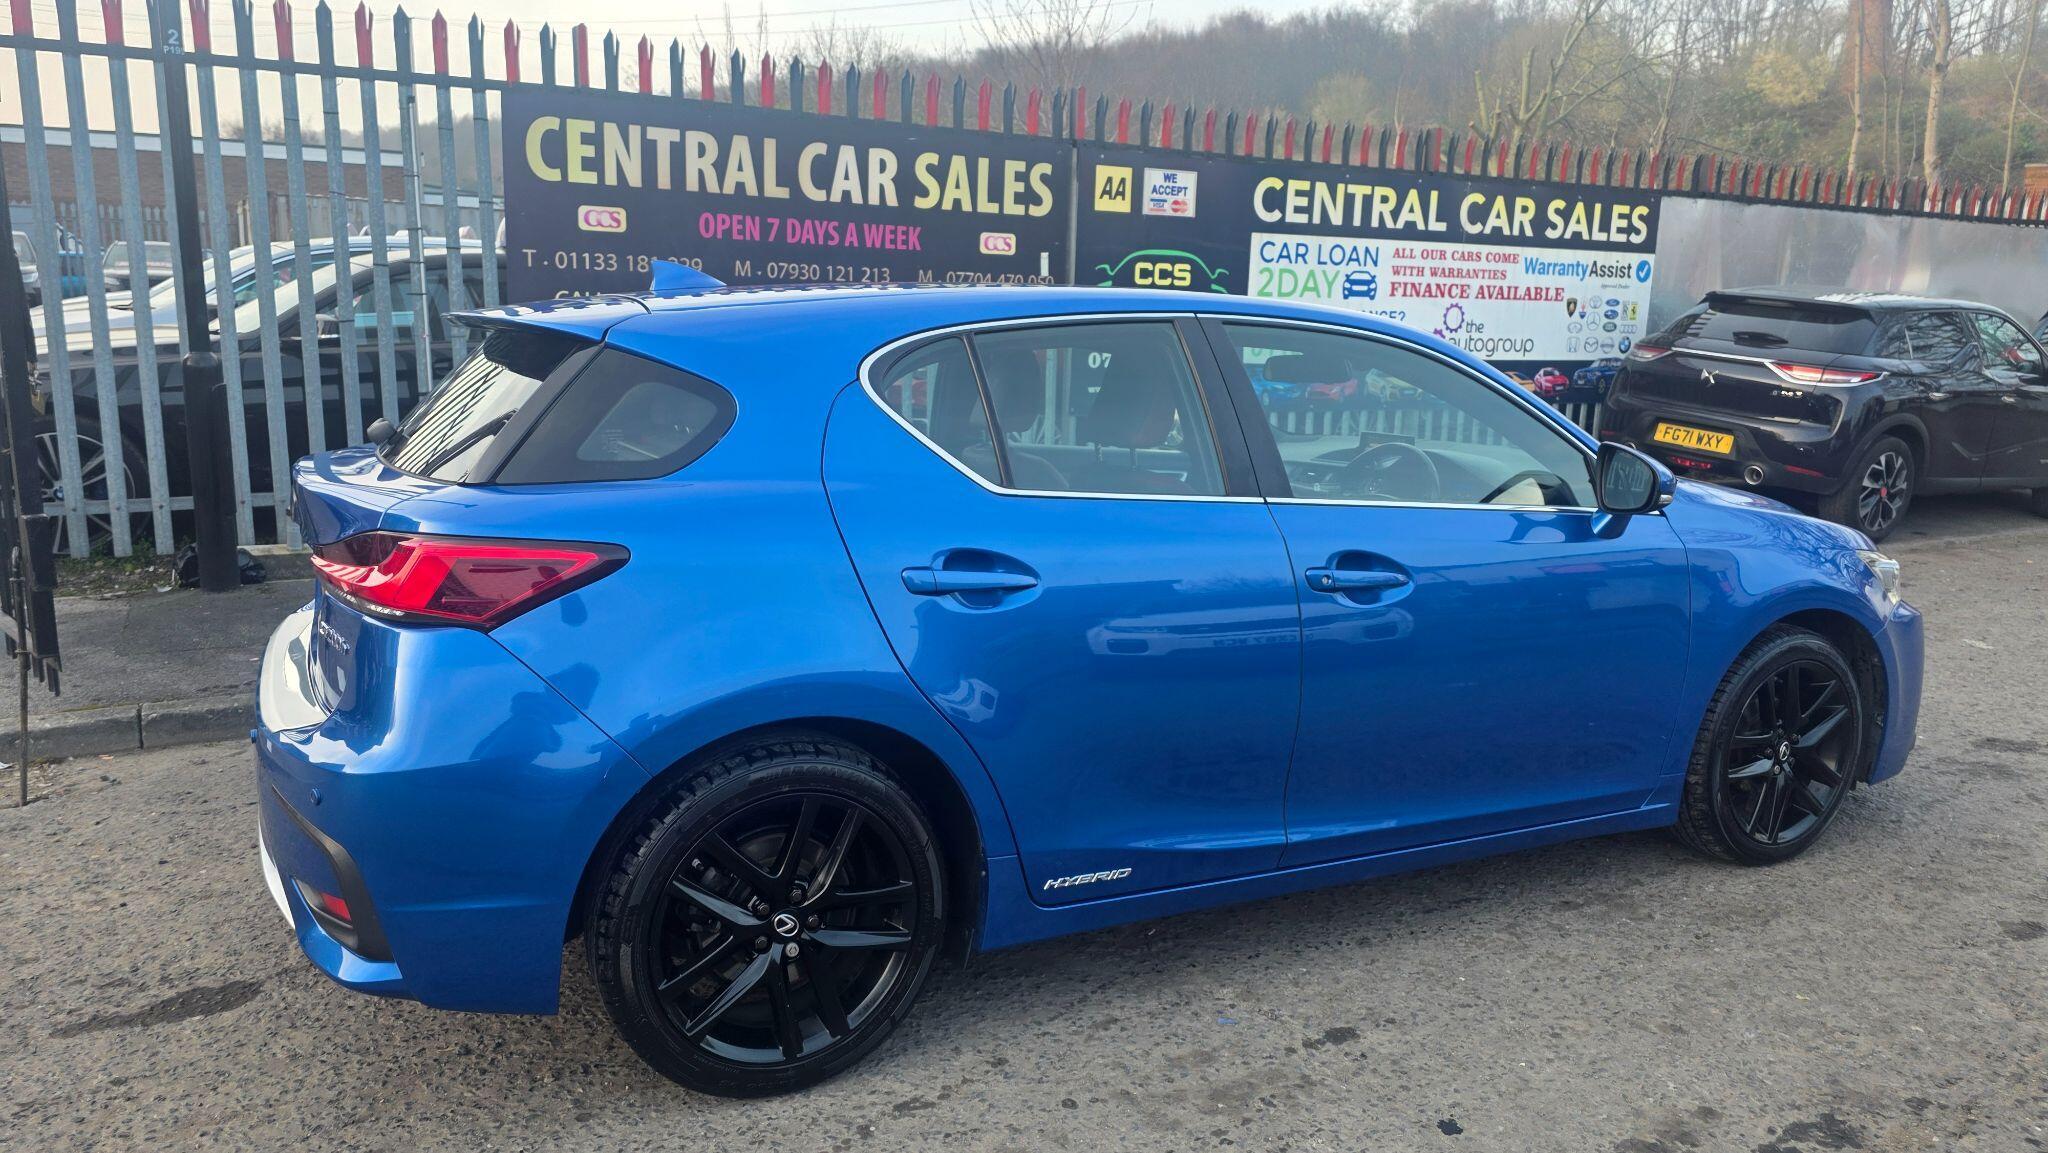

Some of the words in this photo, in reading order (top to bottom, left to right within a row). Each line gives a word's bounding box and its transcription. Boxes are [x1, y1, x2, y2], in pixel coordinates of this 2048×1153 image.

[168, 29, 179, 45] 2
[525, 116, 791, 199] CENTRAL
[798, 142, 899, 207] CAR
[913, 152, 1053, 217] SALES
[1099, 176, 1127, 201] AA
[1163, 172, 1178, 184] WE
[1151, 184, 1188, 197] ACCEPT
[583, 209, 622, 229] CCS
[1253, 176, 1447, 231] CENTRAL
[1459, 192, 1536, 238] CAR
[1544, 199, 1650, 244] SALES
[699, 212, 760, 241] OPEN
[767, 217, 780, 242] 7
[786, 218, 839, 246] DAYS
[844, 223, 859, 247] A
[863, 223, 921, 250] WEEK
[984, 235, 1012, 252] CCS
[1259, 240, 1309, 264] CAR
[1317, 243, 1379, 267] LOAN
[554, 251, 618, 271] 01133
[1392, 247, 1416, 260] ALL
[1420, 249, 1447, 261] OUR
[1451, 250, 1482, 263] CARS
[1485, 252, 1520, 264] COME
[767, 262, 820, 280] 07930
[827, 265, 854, 282] 121
[861, 267, 890, 283] 213
[1134, 261, 1192, 287] CCS
[1392, 265, 1425, 278] WITH
[1429, 266, 1507, 281] WARRANTIES
[1524, 256, 1632, 281] WarrantyAssist
[1257, 267, 1341, 299] 2DAY
[1389, 281, 1471, 299] FINANCE
[1475, 285, 1565, 302] AVAILABLE
[1465, 320, 1484, 333] the
[1088, 352, 1112, 368] 07
[1662, 426, 1694, 443] FG71
[1695, 432, 1724, 449] WXY
[1043, 867, 1132, 891] HYBRID
